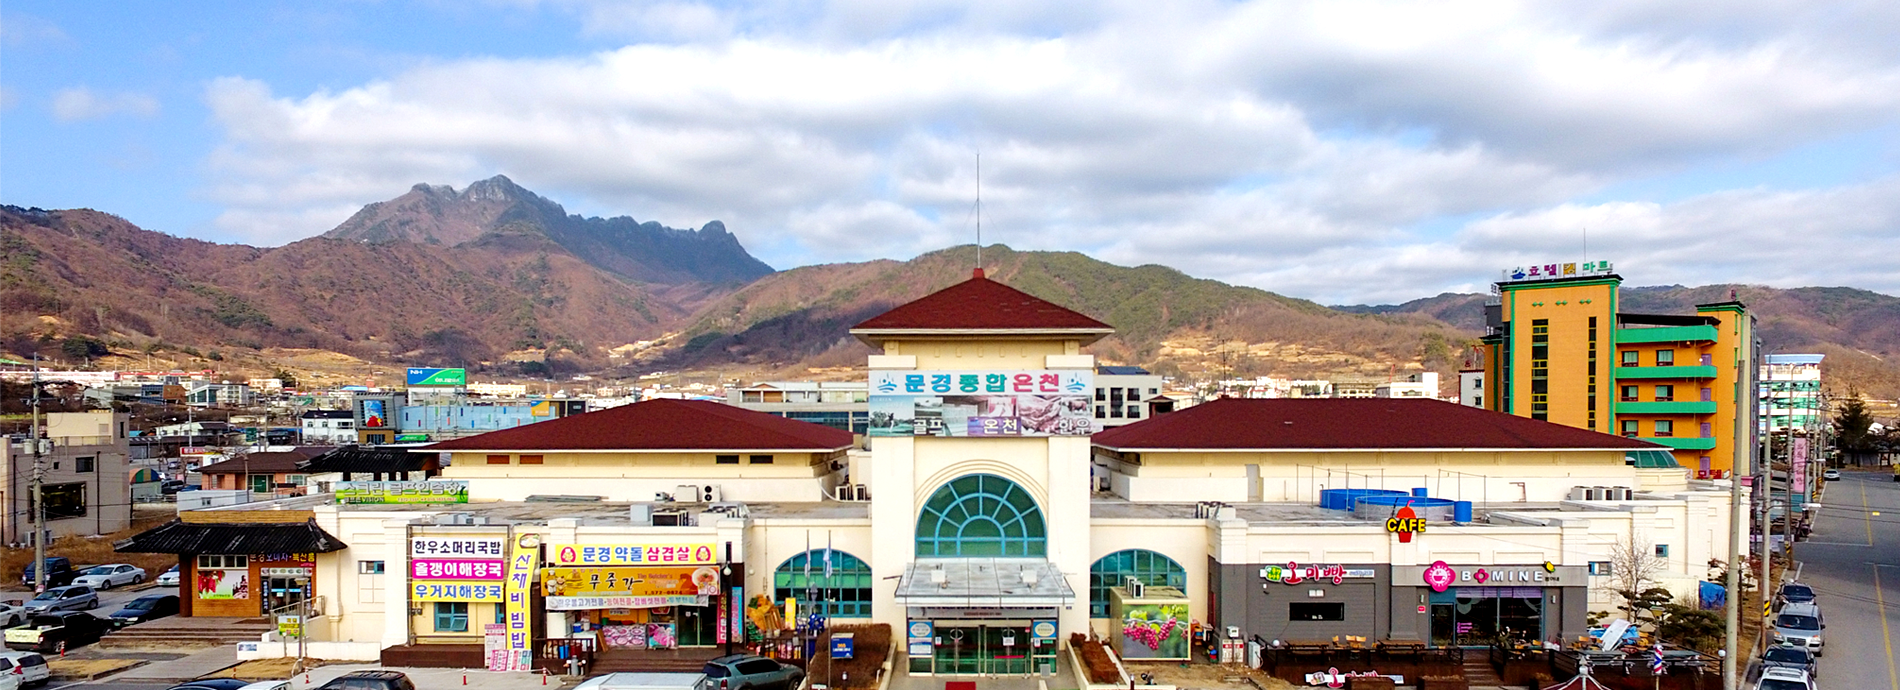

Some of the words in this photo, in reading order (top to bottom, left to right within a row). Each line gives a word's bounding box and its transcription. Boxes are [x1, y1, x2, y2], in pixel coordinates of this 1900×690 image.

[914, 418, 944, 434] 골프
[983, 418, 1018, 435] 온천
[1058, 418, 1090, 435] 한우
[344, 482, 384, 495] 스크린
[1386, 518, 1426, 532] CAFE
[415, 541, 501, 554] 한우소머리국밥
[646, 547, 690, 562] 삼겹살
[415, 562, 501, 577] 올갱이해장국
[1284, 561, 1347, 584] 오미빵
[415, 584, 501, 599] 우거지해장국
[511, 555, 531, 648] 산채비빔밥
